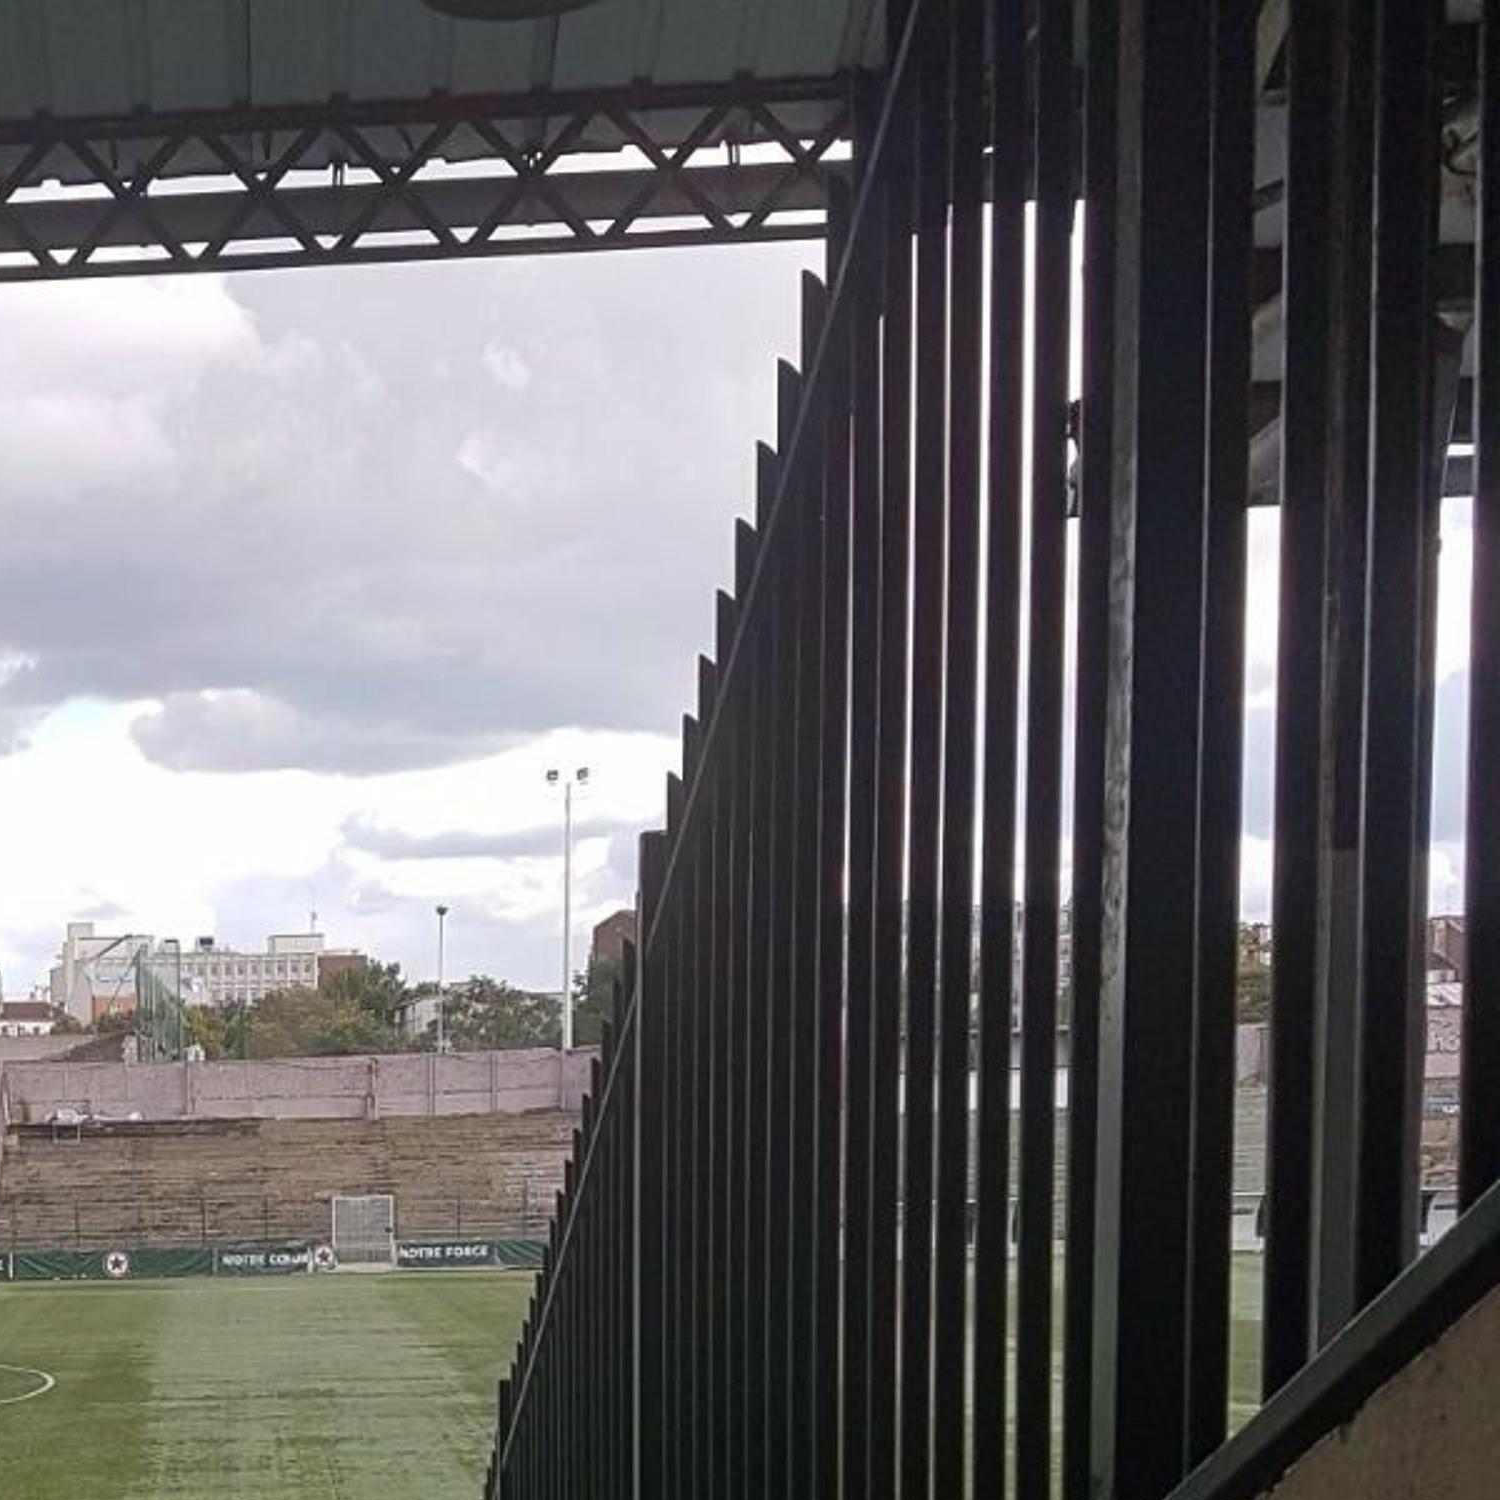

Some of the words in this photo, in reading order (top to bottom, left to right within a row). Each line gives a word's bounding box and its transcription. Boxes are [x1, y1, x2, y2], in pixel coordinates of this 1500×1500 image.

[222, 1255, 265, 1266] NOTRE
[400, 1246, 443, 1259] NOTRE
[445, 1244, 489, 1259] FORCE
